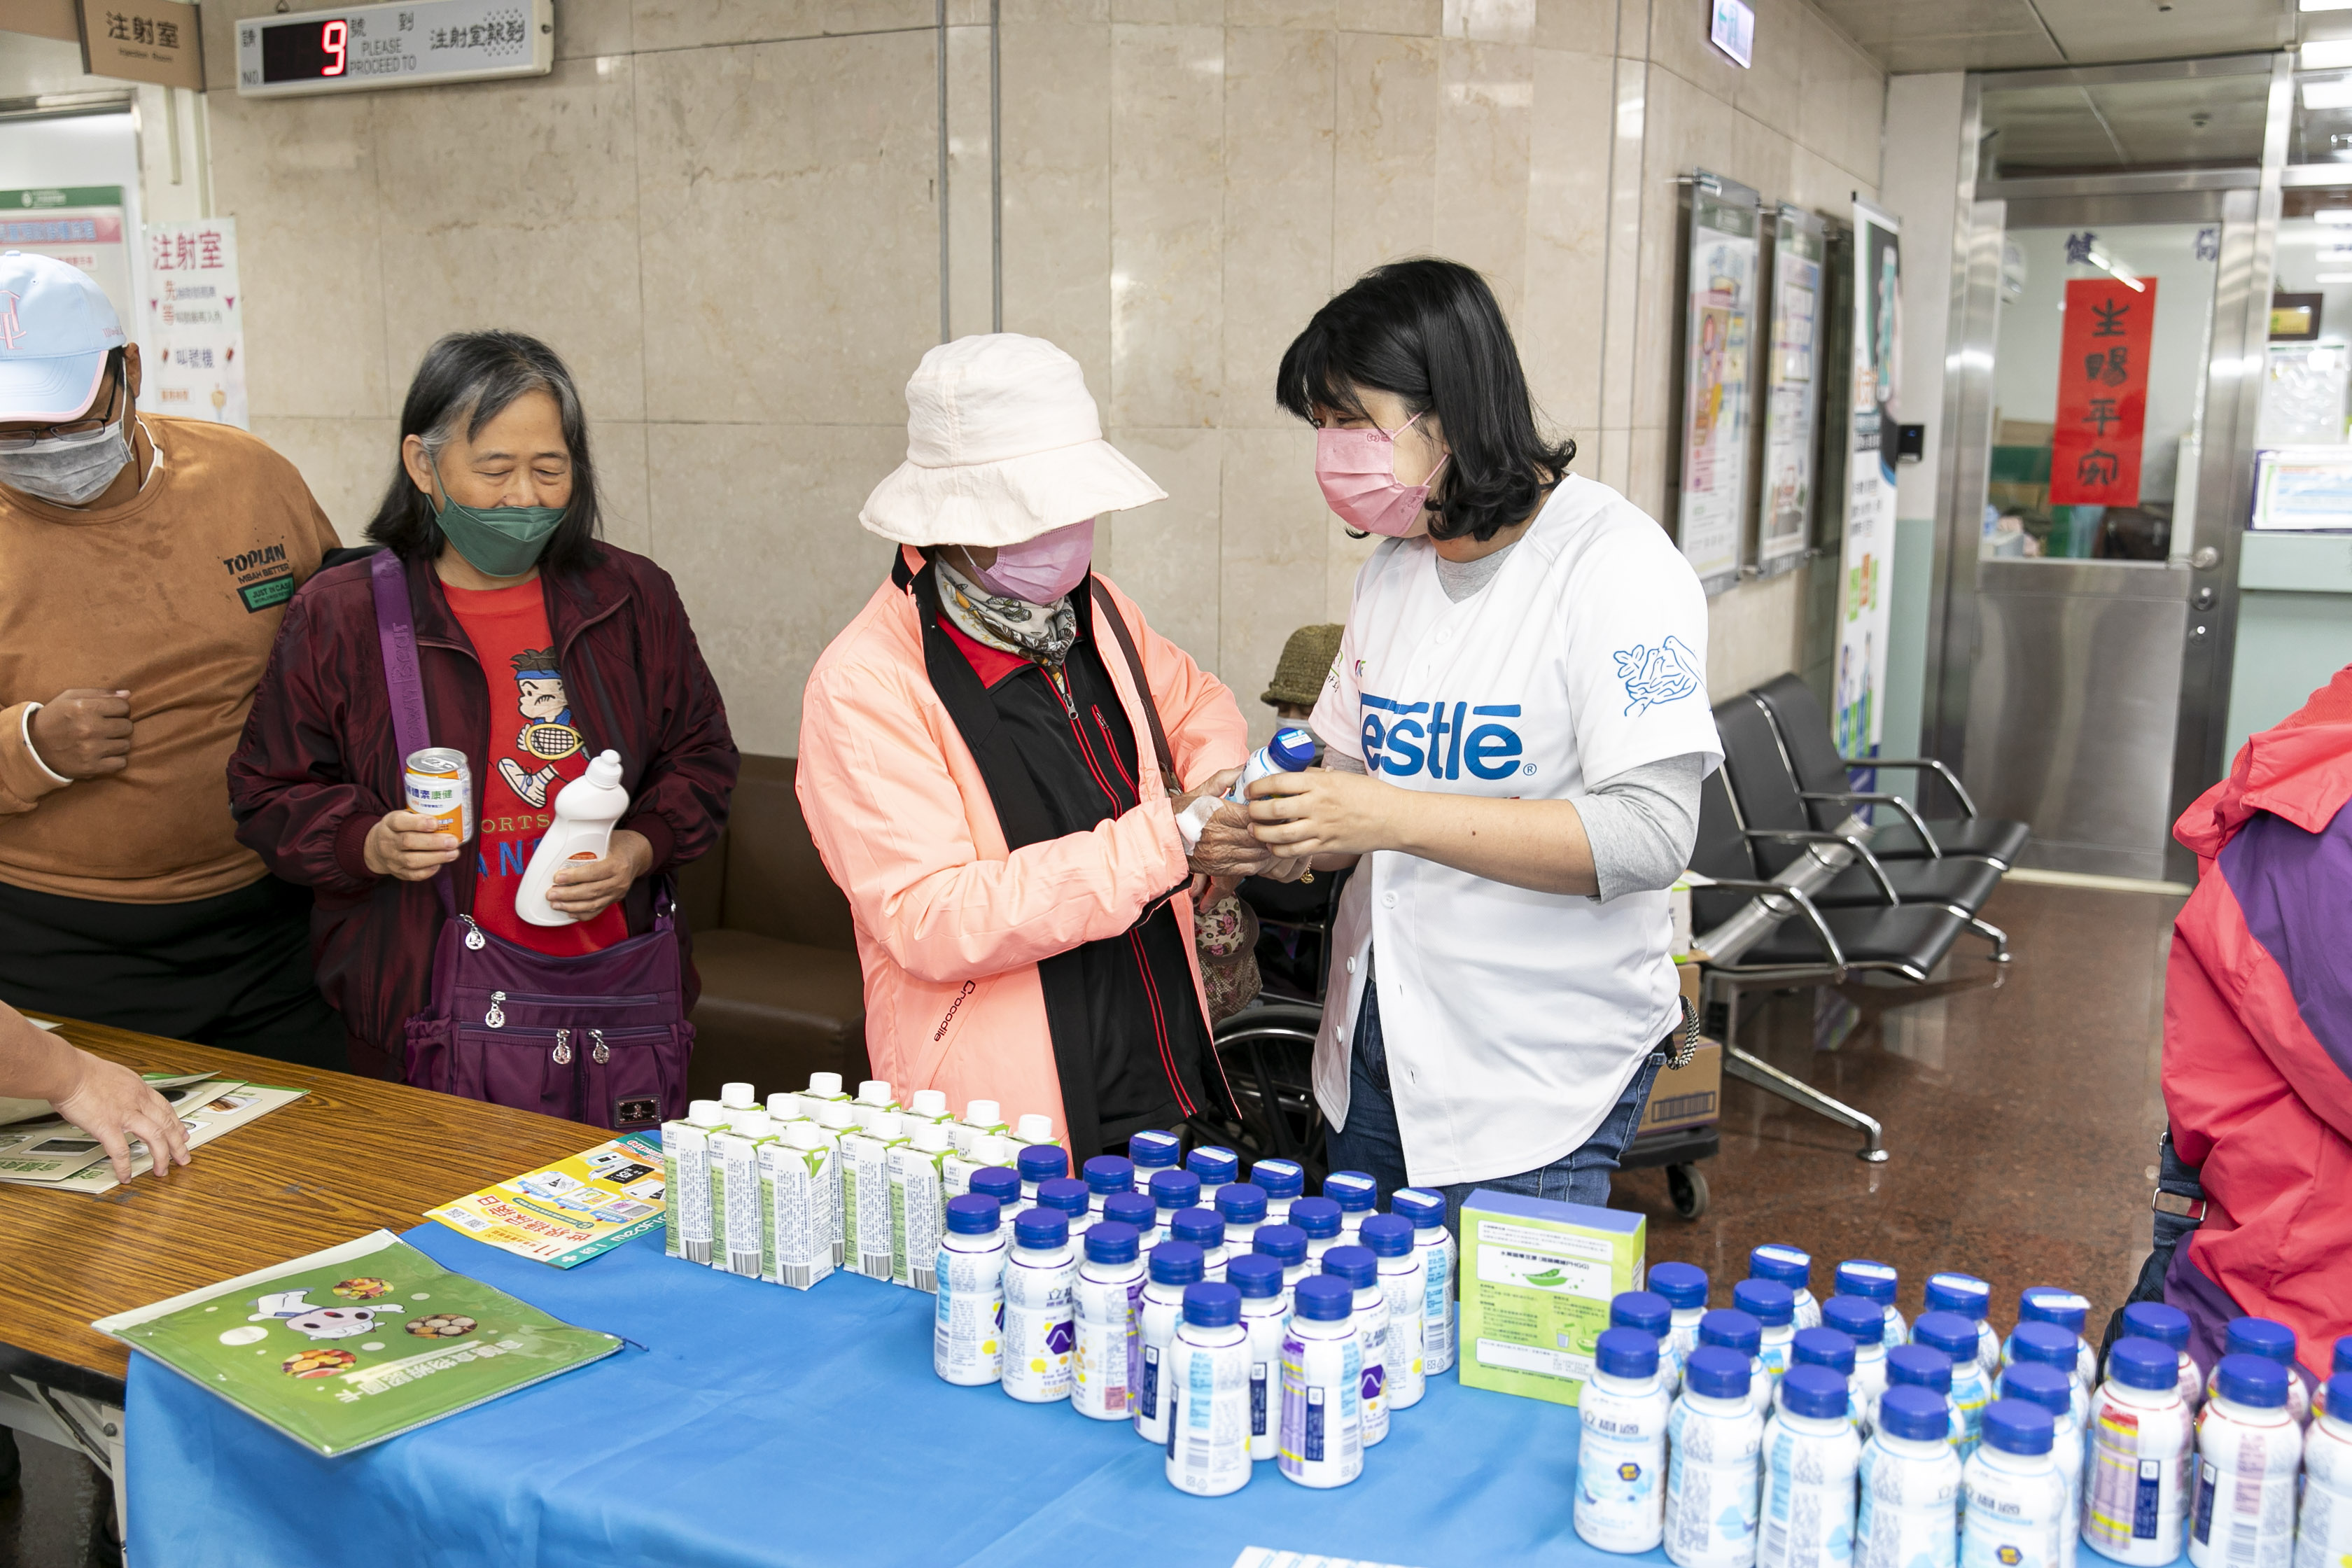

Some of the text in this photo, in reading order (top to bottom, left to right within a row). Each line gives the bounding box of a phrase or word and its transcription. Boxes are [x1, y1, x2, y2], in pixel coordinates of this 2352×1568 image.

[106, 10, 179, 49] 注射室
[241, 11, 414, 76] 請 9 號 到
[361, 37, 402, 57] PLEASE
[350, 55, 416, 76] PROCEED TO
[153, 230, 224, 270] 注射室
[223, 543, 286, 575] TOPLAN
[262, 563, 290, 577] BETTER
[934, 980, 976, 1042] Crocodile
[611, 1212, 666, 1242] medFir
